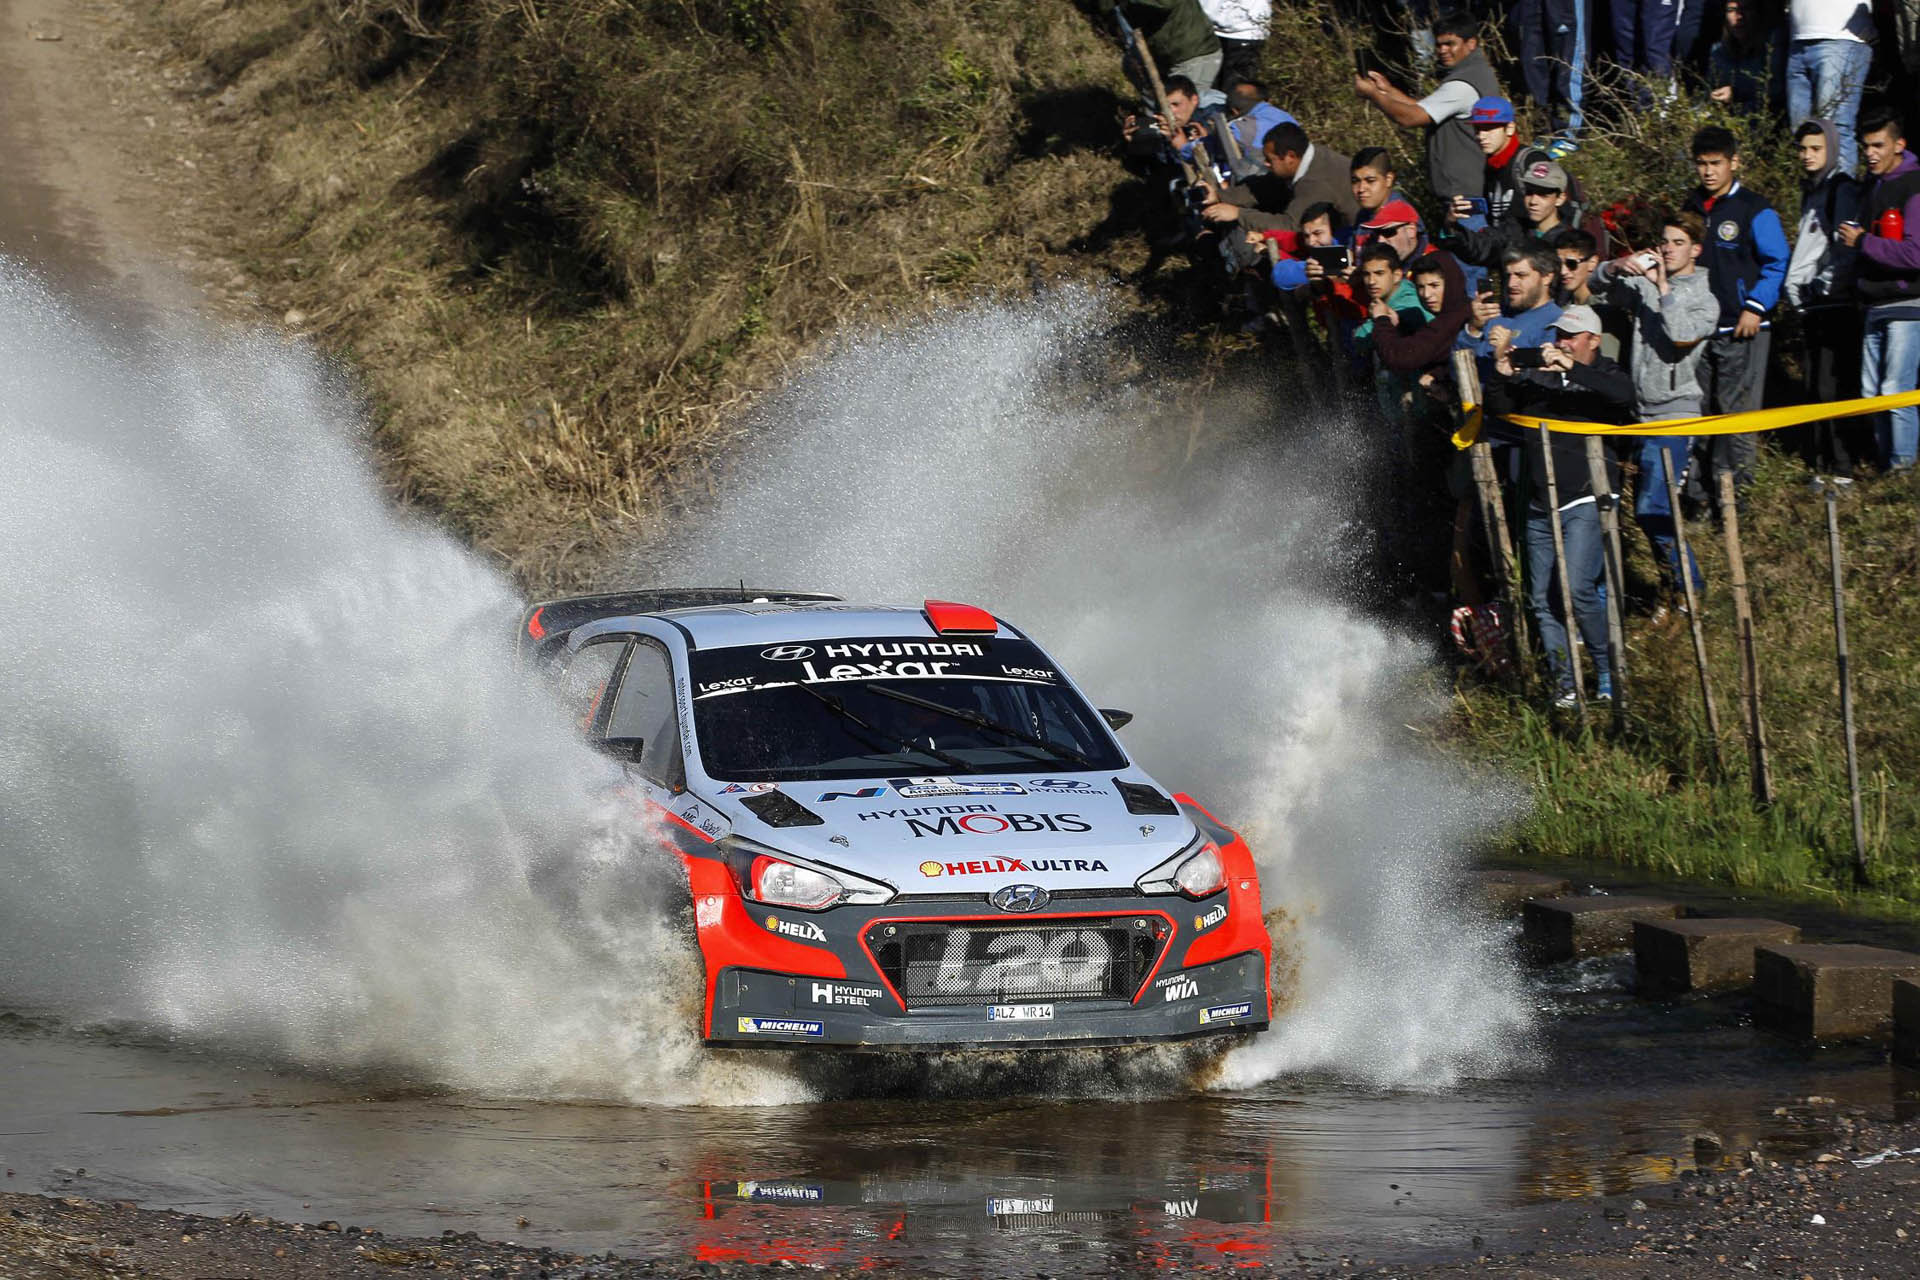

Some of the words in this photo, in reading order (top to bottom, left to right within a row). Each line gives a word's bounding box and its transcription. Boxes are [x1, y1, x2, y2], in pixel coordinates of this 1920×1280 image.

[824, 643, 984, 658] HYUNDAI
[801, 660, 951, 683] Lexar
[1001, 664, 1055, 679] Lexar
[699, 676, 757, 693] Lexar
[909, 787, 970, 795] Argentina
[1028, 787, 1109, 796] HYUNDAI
[857, 804, 998, 821] HYUNDAI
[903, 813, 1093, 838] MOBIS
[944, 856, 1030, 876] HELIX
[1031, 859, 1110, 872] ULTRA
[1202, 904, 1227, 929] HELIX
[778, 920, 828, 943] HELIX
[1155, 973, 1186, 988] HYUNDAI
[835, 985, 883, 998] HYUNDAI
[1165, 978, 1199, 1002] WIA
[835, 995, 870, 1006] STEEL
[995, 1007, 1016, 1019] ALZ
[1210, 1005, 1249, 1018] MICHELIN
[759, 1021, 820, 1032] MICHELIN
